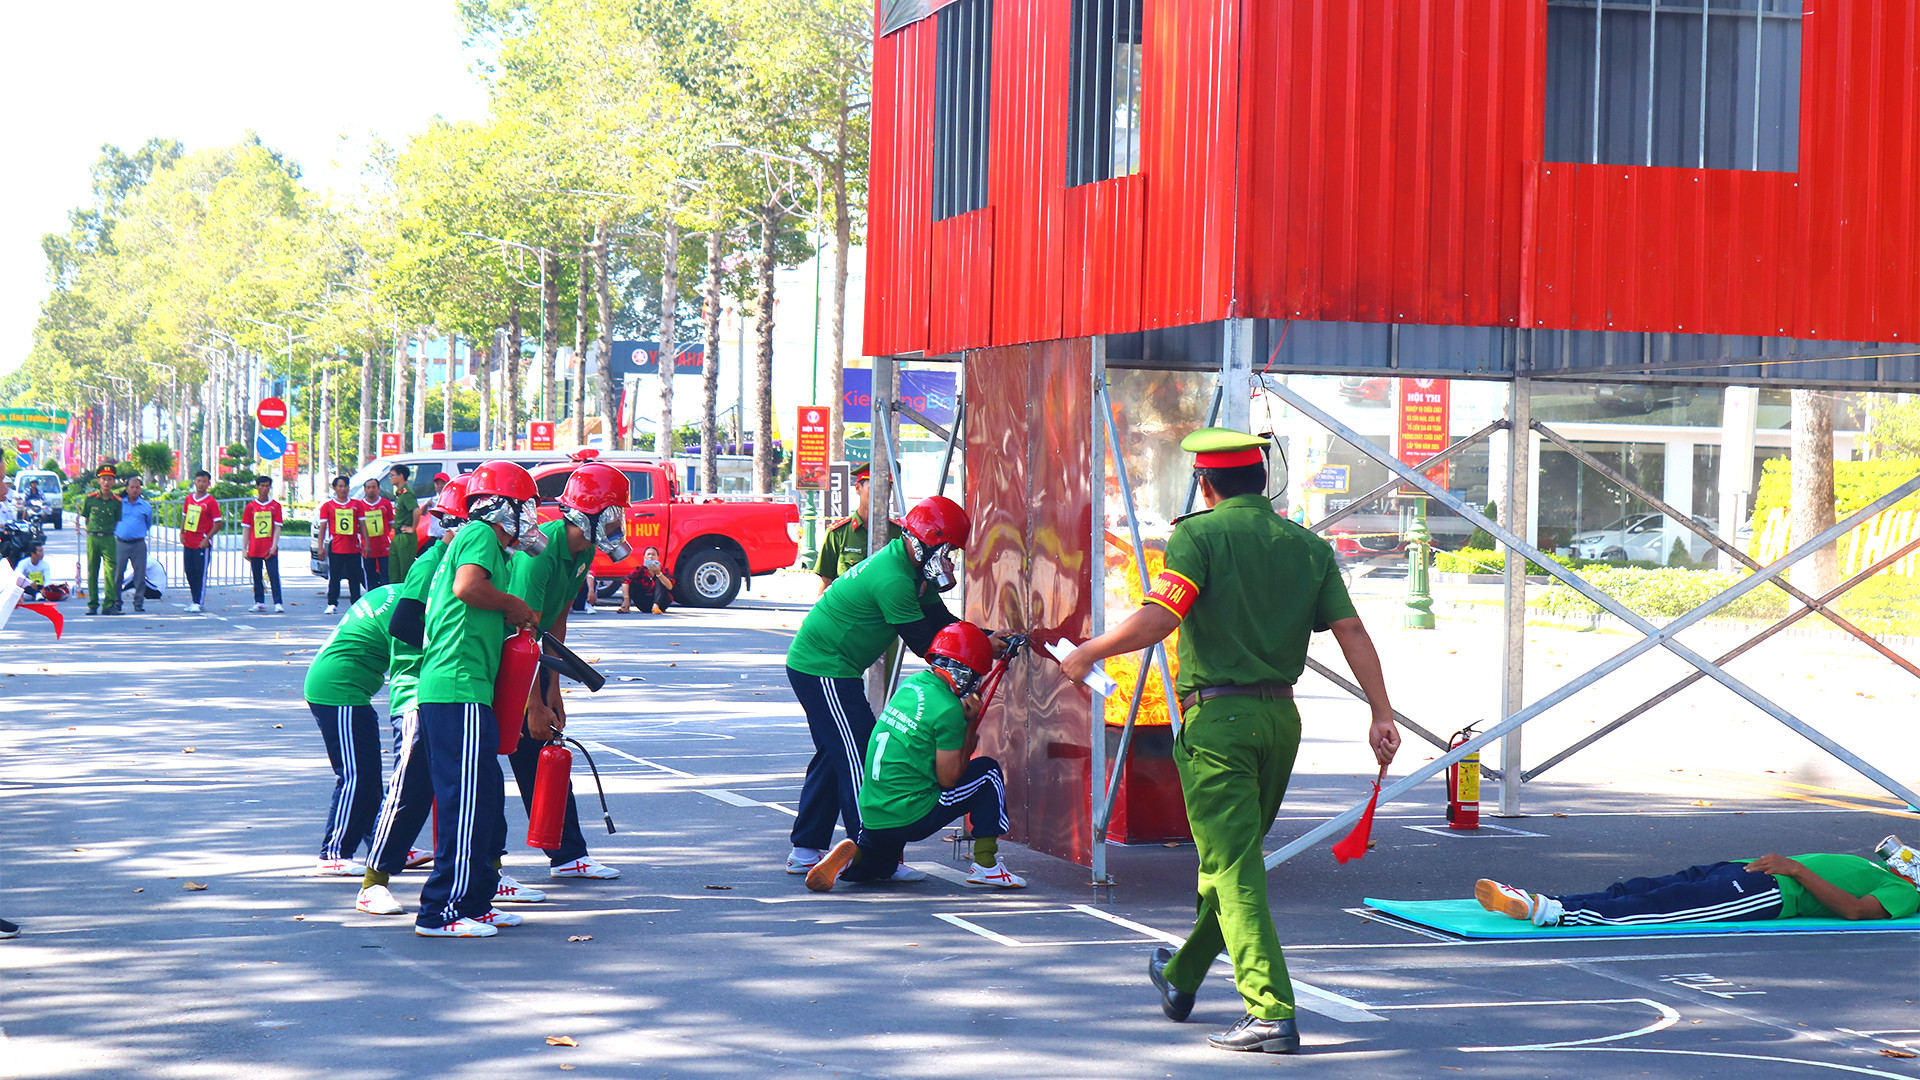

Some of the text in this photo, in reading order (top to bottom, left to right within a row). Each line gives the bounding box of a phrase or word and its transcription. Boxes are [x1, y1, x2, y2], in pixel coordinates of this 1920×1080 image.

[649, 350, 704, 367] YAHA
[1407, 392, 1441, 404] HỘI THI
[187, 515, 195, 528] 4
[258, 521, 268, 534] 2
[340, 518, 349, 531] 6
[371, 520, 378, 533] 1
[635, 523, 660, 537] HUY
[872, 731, 890, 781] 1
